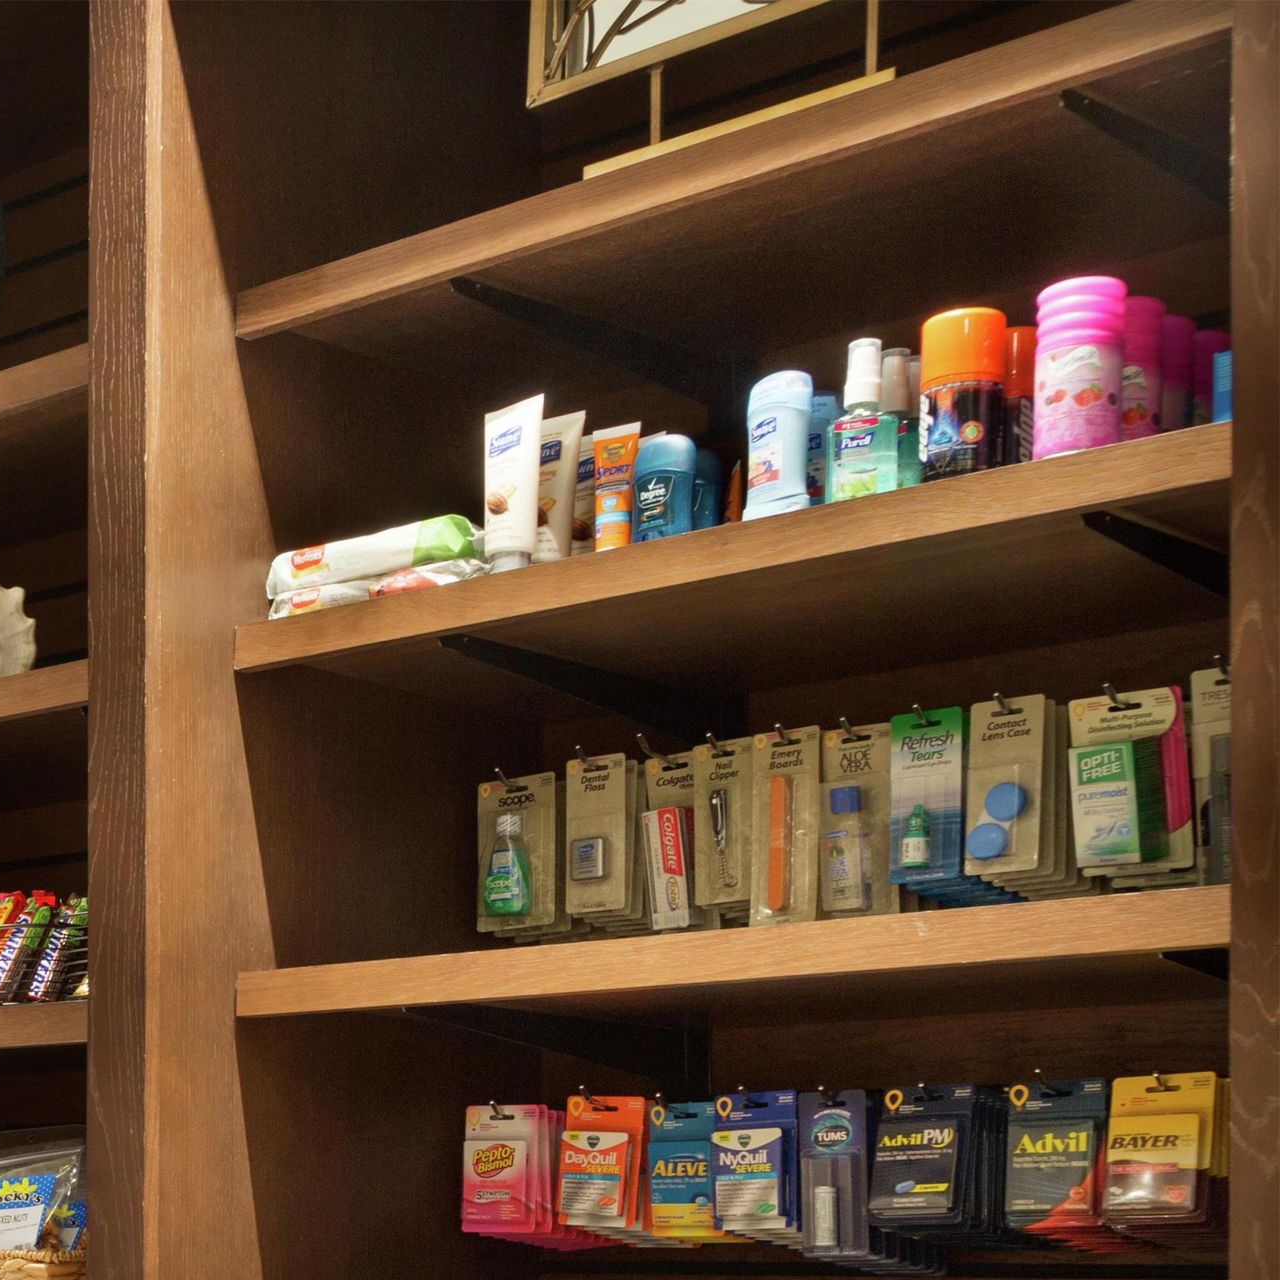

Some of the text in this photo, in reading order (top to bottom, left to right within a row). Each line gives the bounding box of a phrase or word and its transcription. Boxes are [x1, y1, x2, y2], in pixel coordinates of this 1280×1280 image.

[596, 464, 632, 479] SPORT
[640, 488, 667, 501] Degree
[986, 718, 1027, 731] Contact
[1100, 712, 1152, 724] Multi-Purpose
[1088, 718, 1166, 733] Disinfecting Solution
[900, 731, 954, 752] Refresh
[981, 727, 1031, 742] Lens Case
[771, 749, 803, 761] Emery
[840, 750, 871, 763] ALOE
[910, 749, 944, 763] Tears
[1080, 750, 1120, 770] OPTI-
[715, 760, 733, 771] Nail
[769, 758, 804, 770] Boards
[840, 760, 872, 773] VERA
[580, 773, 610, 785] Dental
[709, 769, 739, 782] Clipper
[1082, 762, 1122, 782] FREE
[584, 783, 606, 793] Floss
[1078, 786, 1129, 804] puremoist
[498, 792, 536, 808] scope
[662, 813, 678, 870] Colgate
[816, 1130, 848, 1142] TUMS
[878, 1128, 951, 1147] Advil PM
[1014, 1131, 1088, 1154] Advil
[1110, 1135, 1180, 1151] BAYER
[479, 1155, 513, 1174] Bismol
[565, 1151, 617, 1167] DayQuil
[719, 1149, 767, 1169] NyQuil
[585, 1164, 621, 1173] SEVERE
[651, 1159, 709, 1177] ALEVE
[735, 1163, 772, 1174] SEVERE
[476, 1190, 482, 1200] 5
